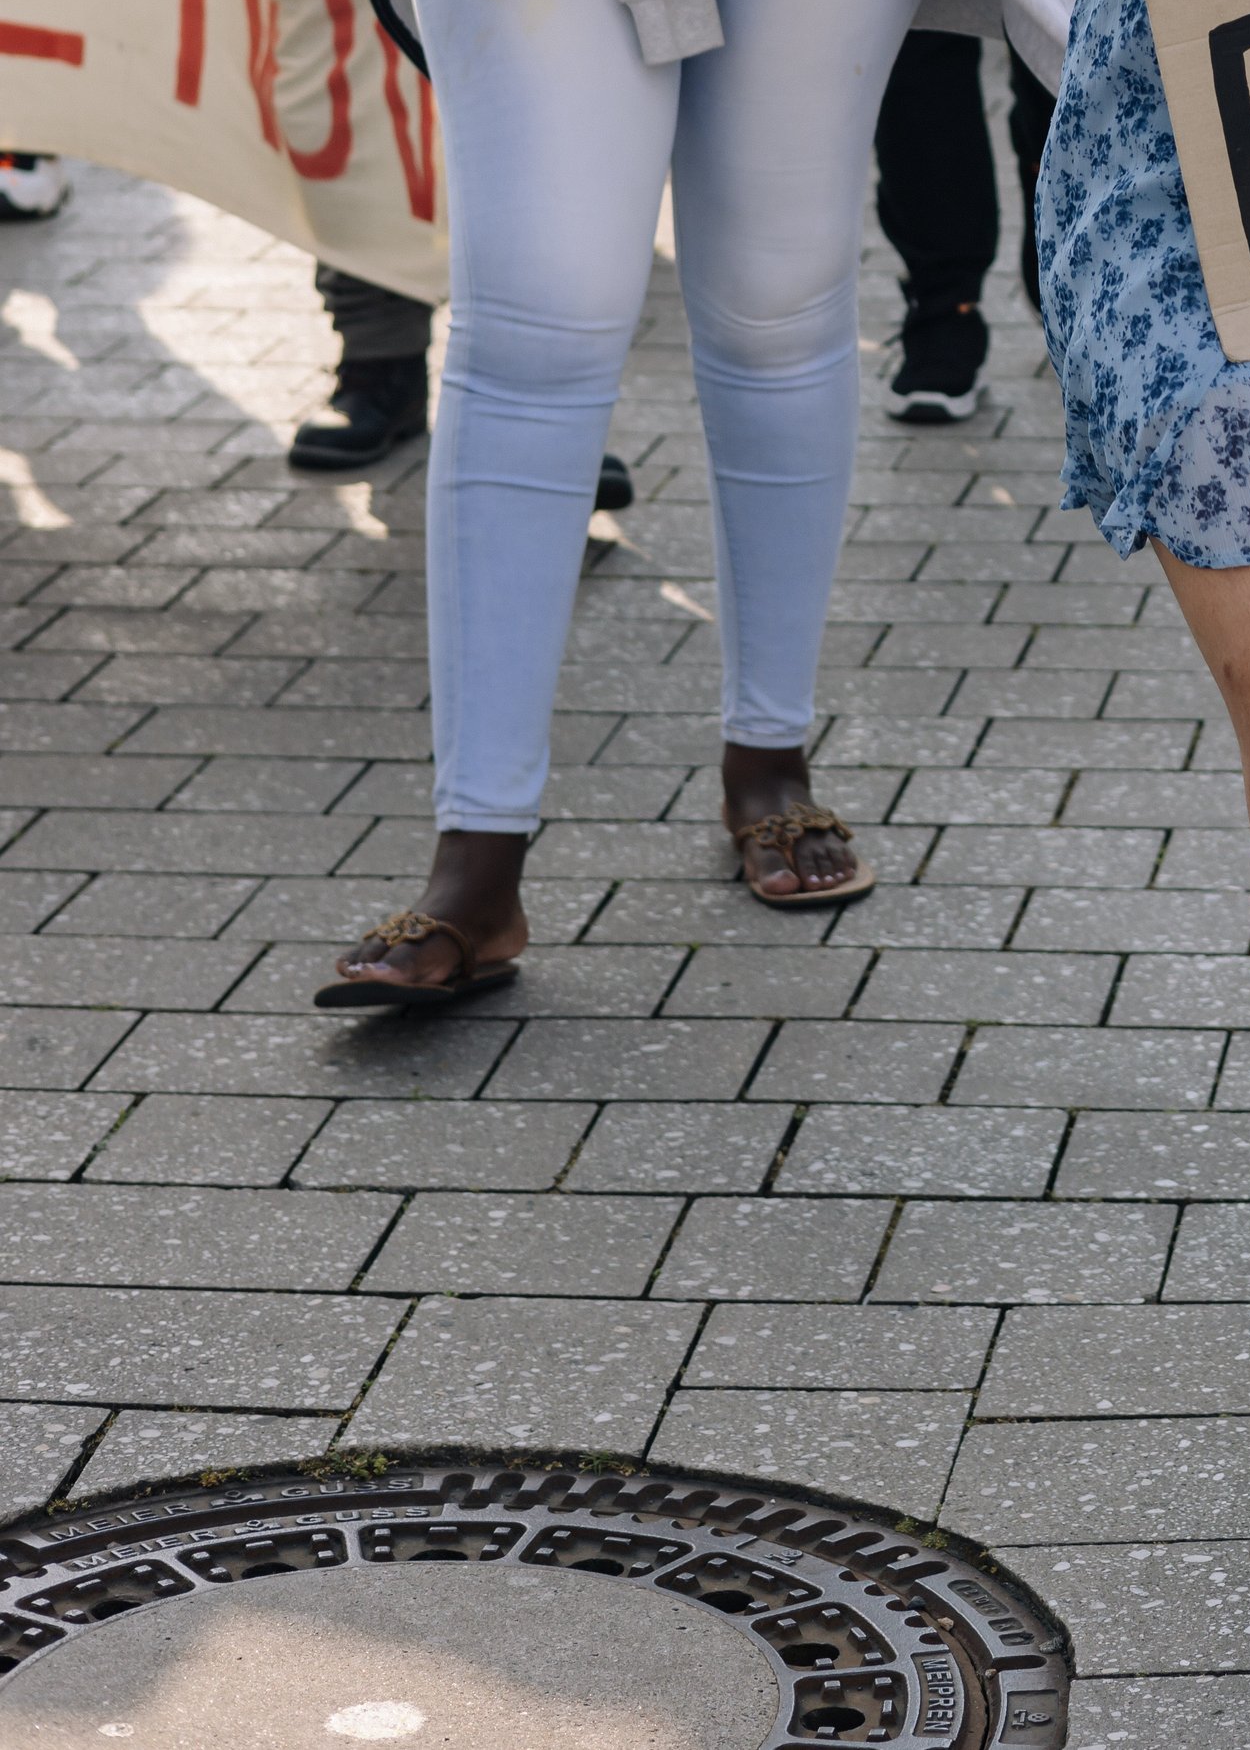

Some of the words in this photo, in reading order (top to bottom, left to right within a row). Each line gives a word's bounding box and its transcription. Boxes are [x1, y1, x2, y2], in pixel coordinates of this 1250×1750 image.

[48, 1503, 193, 1541] MEIER
[280, 1477, 414, 1499] GUSS
[72, 1528, 218, 1571] MEIER
[295, 1505, 431, 1527] GUSS
[921, 1657, 954, 1734] MEIPREN
